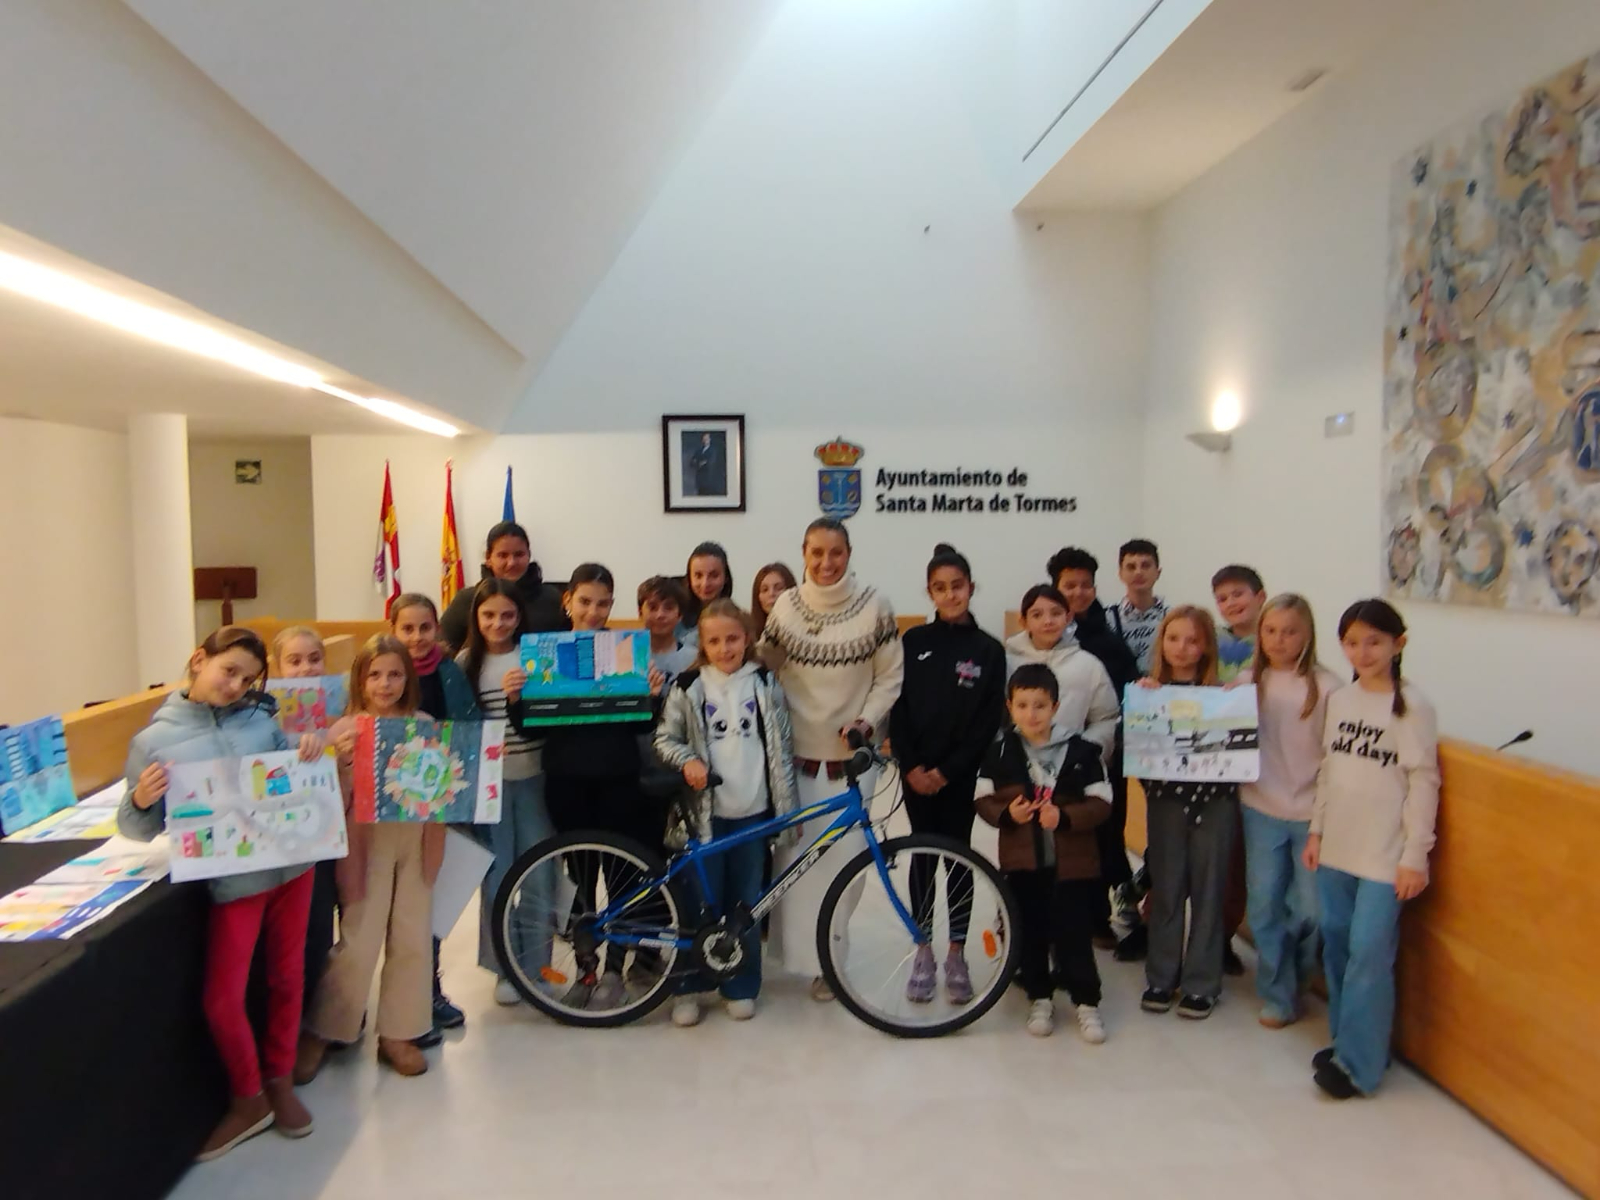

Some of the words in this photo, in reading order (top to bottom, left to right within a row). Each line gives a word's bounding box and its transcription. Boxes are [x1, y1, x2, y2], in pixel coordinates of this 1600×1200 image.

[875, 467, 1003, 491] Ayuntamiento
[1007, 467, 1028, 487] de
[875, 493, 927, 513] Santa
[931, 493, 984, 513] Marta
[988, 493, 1010, 513] de
[1014, 493, 1077, 513] Tormes
[1338, 719, 1385, 744] enjoy
[1331, 736, 1353, 755] old
